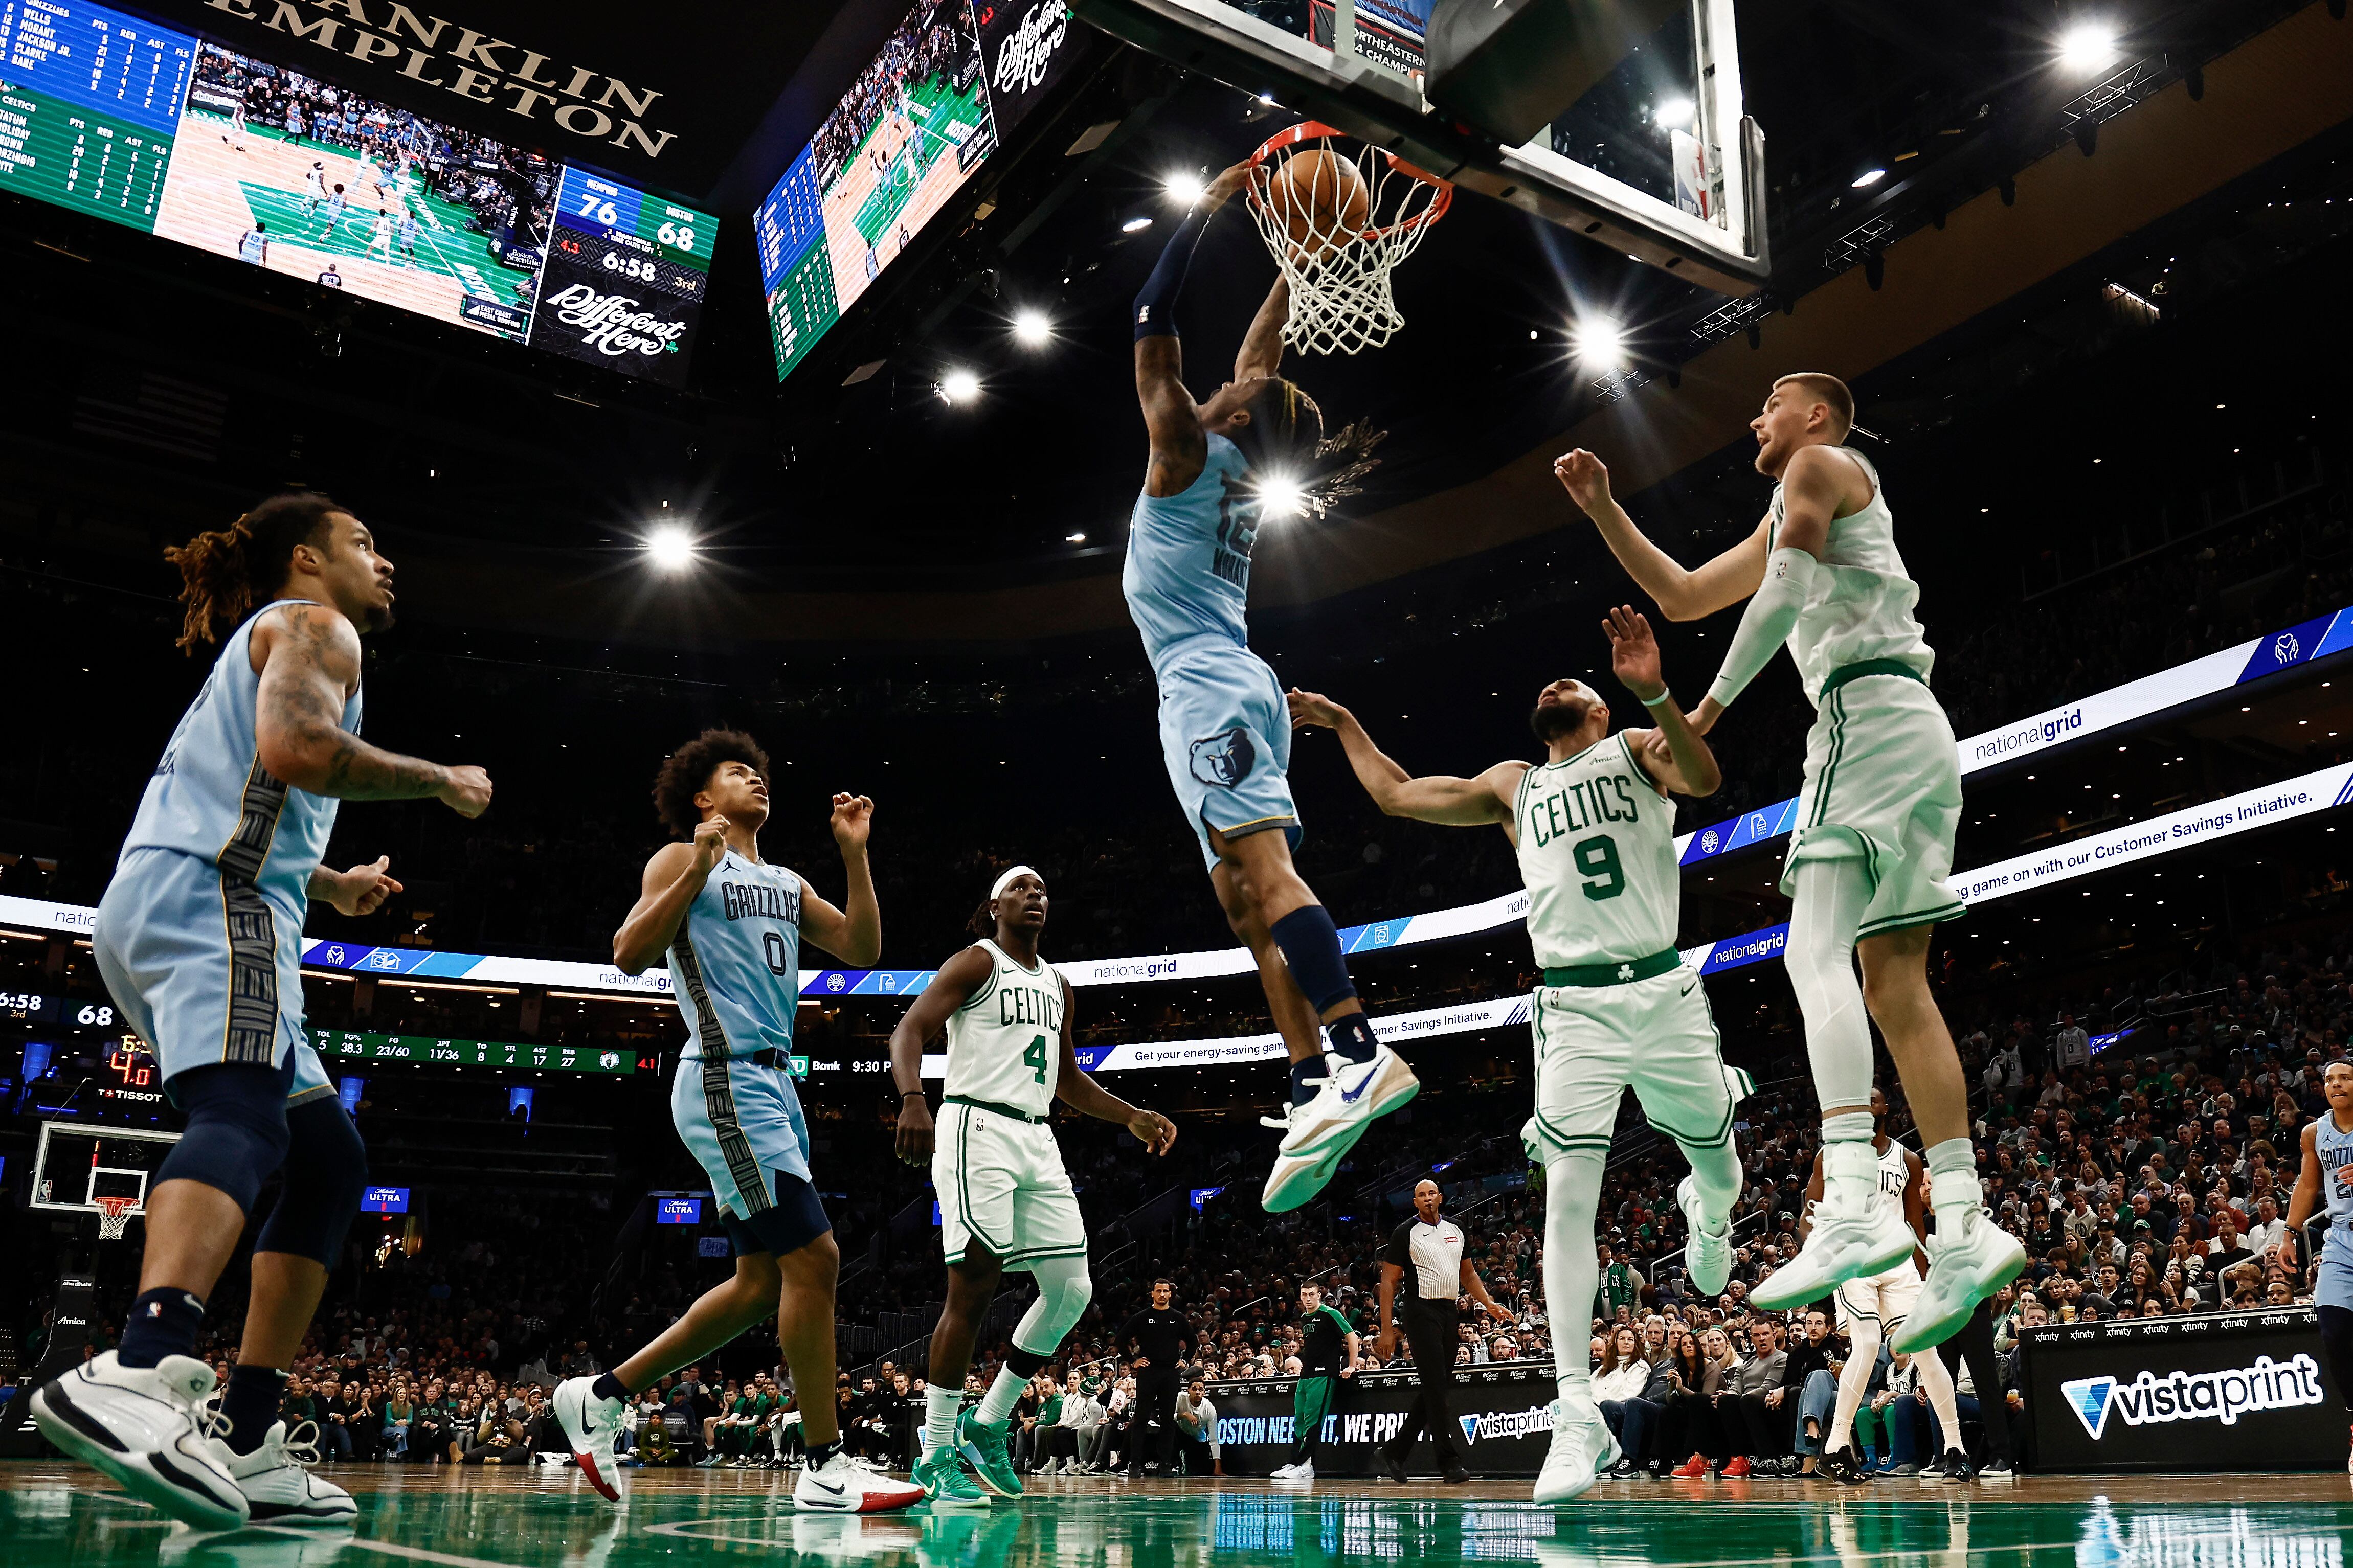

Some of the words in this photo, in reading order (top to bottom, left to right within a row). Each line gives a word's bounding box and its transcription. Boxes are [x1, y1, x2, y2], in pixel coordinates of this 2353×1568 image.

[26, 0, 70, 17] GRIZZLIES
[3, 13, 13, 25] 12
[19, 19, 56, 39] MORANT
[97, 45, 107, 56] 21
[23, 7, 51, 25] WELLS
[178, 61, 186, 71] 2
[92, 19, 108, 31] PTS
[119, 28, 136, 40] REB
[147, 38, 165, 50] AST
[175, 47, 189, 58] FLS
[993, 0, 1067, 93] Differen
[1354, 28, 1425, 66] ORTHEASTERN
[17, 31, 56, 52] JACKSON
[57, 45, 71, 57] JR.
[95, 56, 105, 68] 13
[123, 65, 130, 76] 7
[173, 83, 180, 94] 2
[312, 0, 664, 117] ANKLIN
[1366, 50, 1411, 76] CHAMPI
[11, 54, 35, 70] BANE
[91, 80, 98, 90] 5
[117, 88, 124, 100] 2
[144, 98, 151, 108] 2
[168, 105, 175, 116] 2
[14, 42, 48, 61] CLARKE
[92, 68, 102, 79] 16
[147, 86, 154, 97] 2
[170, 95, 178, 105] 3
[204, 0, 678, 157] EMPLETON
[2, 95, 36, 112] CELTICS
[0, 134, 24, 151] ROWN
[69, 117, 85, 129] PTS
[97, 126, 114, 138] REB
[125, 137, 143, 147] AST
[152, 144, 167, 155] FLS
[72, 145, 84, 157] 20
[102, 154, 109, 165] 2
[155, 159, 162, 169] 2
[69, 169, 78, 180] 10
[123, 186, 130, 196] 2
[147, 193, 154, 203] 3
[94, 190, 101, 199] 3
[121, 197, 127, 208] 3
[578, 194, 618, 225] 76
[657, 222, 694, 251] 68
[666, 206, 694, 222] BOSTON
[641, 244, 655, 254] LEFT
[560, 239, 580, 254] 4.3
[602, 252, 656, 282] 6:58
[675, 276, 696, 291] 3rd
[481, 305, 495, 314] EAST
[546, 284, 686, 339] Different
[581, 321, 665, 356] Here
[1976, 709, 2082, 760] nationalgrid
[1531, 775, 1638, 848] CELTICS
[1973, 876, 2009, 896] game
[2013, 870, 2029, 882] on
[2034, 858, 2063, 876] with
[2068, 853, 2090, 867] our
[2095, 831, 2167, 858] Customer
[2172, 814, 2233, 837] Savings
[2238, 793, 2313, 820] Initiative.
[1573, 834, 1625, 901] 9
[722, 882, 799, 926] GRIZZLIE
[1507, 895, 1530, 914] nati
[55, 912, 97, 926] natio
[763, 932, 786, 976] 0
[1716, 933, 1784, 964] nationalgrid
[600, 973, 671, 990] nationalgr
[1095, 959, 1176, 978] nationalgrid
[0, 992, 41, 1010] 6:58
[1000, 987, 1061, 1035] CELTICS
[10, 1010, 26, 1019] 3rd
[78, 1006, 113, 1026] 68
[1373, 1026, 1398, 1035] omer
[1401, 1019, 1441, 1031] Savings
[1445, 1012, 1492, 1026] Initiative.
[319, 1040, 327, 1050] 5
[341, 1042, 363, 1054] 38.3
[376, 1046, 410, 1057] 23/60
[430, 1049, 459, 1060] 11/36
[478, 1052, 485, 1062] 8
[506, 1054, 514, 1063] 4
[534, 1055, 547, 1065] 17
[561, 1057, 575, 1067] 27
[638, 1058, 655, 1070] 4.1
[813, 1061, 840, 1071] Bank
[1023, 1034, 1047, 1085] 4
[1135, 1052, 1154, 1060] Get
[1157, 1052, 1181, 1061] your
[1184, 1045, 1260, 1058] energy-saving
[110, 1052, 150, 1085] 4.0
[853, 1061, 880, 1072] 9:30
[116, 1090, 163, 1102] TISSOT
[57, 1316, 85, 1325] Amica
[2106, 1327, 2131, 1337] xfinity
[2143, 1324, 2169, 1334] xfinity
[2181, 1322, 2208, 1332] xfinity
[2221, 1319, 2248, 1329] xfinity
[2261, 1315, 2290, 1326] xfinity
[2035, 1332, 2059, 1342] xfinity
[2070, 1330, 2095, 1340] xfinity
[2119, 1361, 2316, 1418] vistaprint
[1218, 1418, 1266, 1445] OSTON
[1268, 1417, 1295, 1444] NEE
[1345, 1414, 1371, 1442] WE
[1374, 1413, 1408, 1442] PRI
[1480, 1410, 1551, 1436] vistaprint
